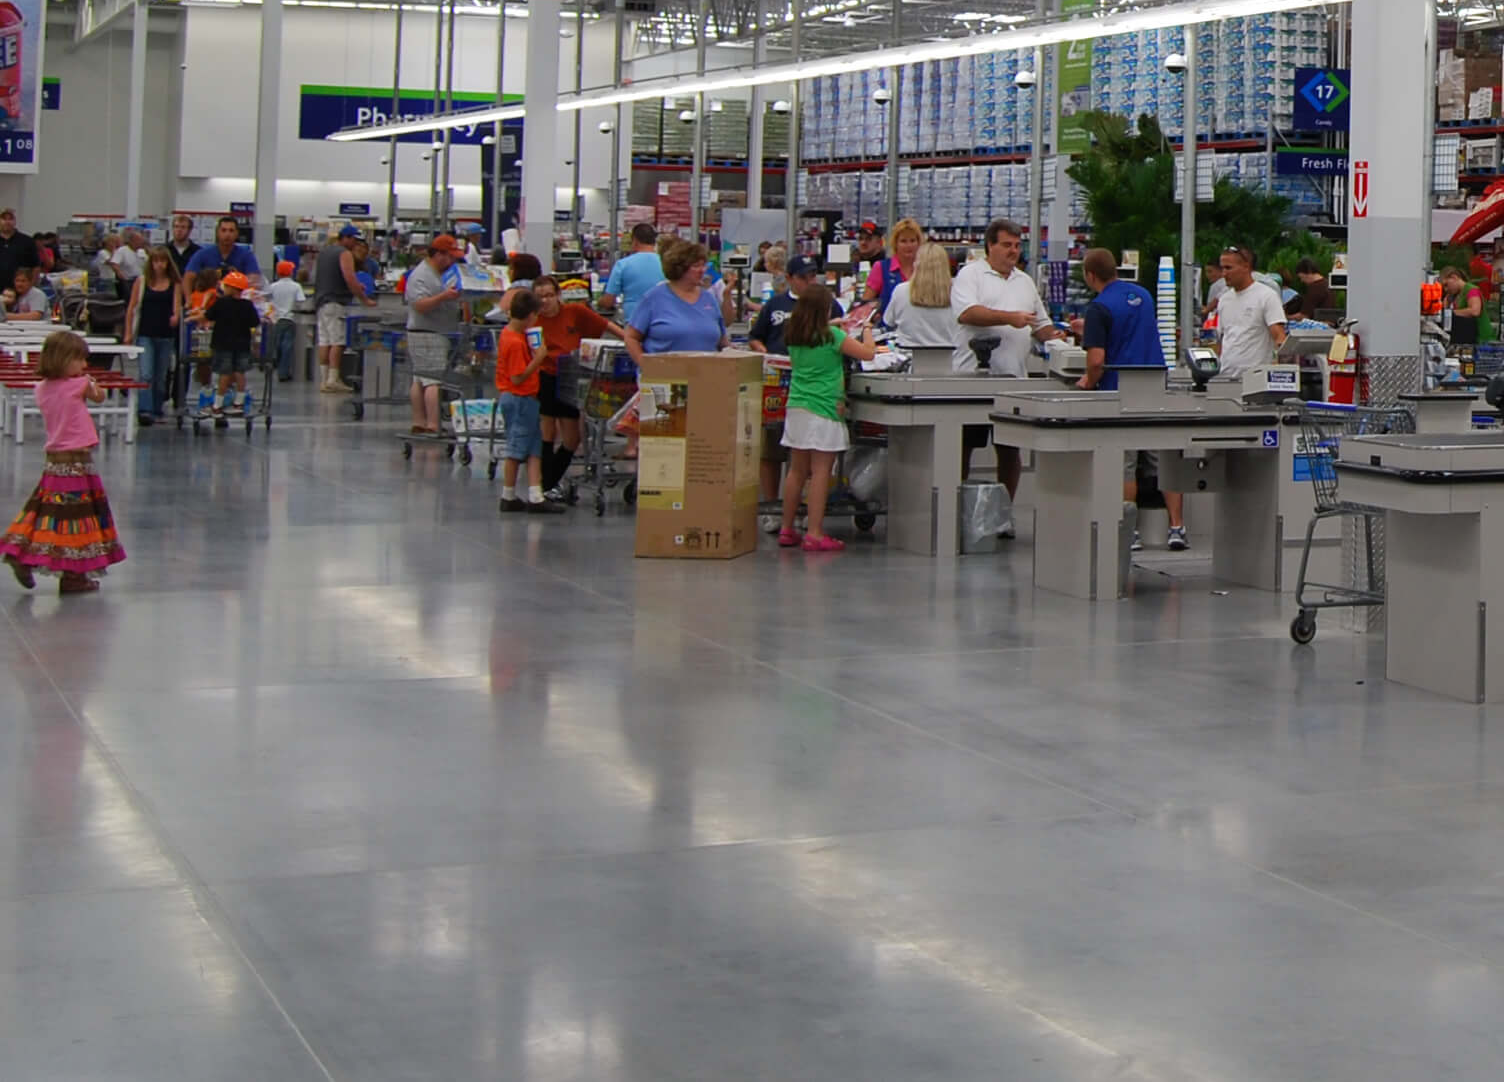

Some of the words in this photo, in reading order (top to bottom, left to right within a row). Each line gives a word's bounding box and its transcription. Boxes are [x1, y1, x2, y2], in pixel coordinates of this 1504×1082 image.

[1316, 85, 1334, 100] 17
[357, 107, 477, 137] Phcy
[1302, 157, 1333, 169] Fresh
